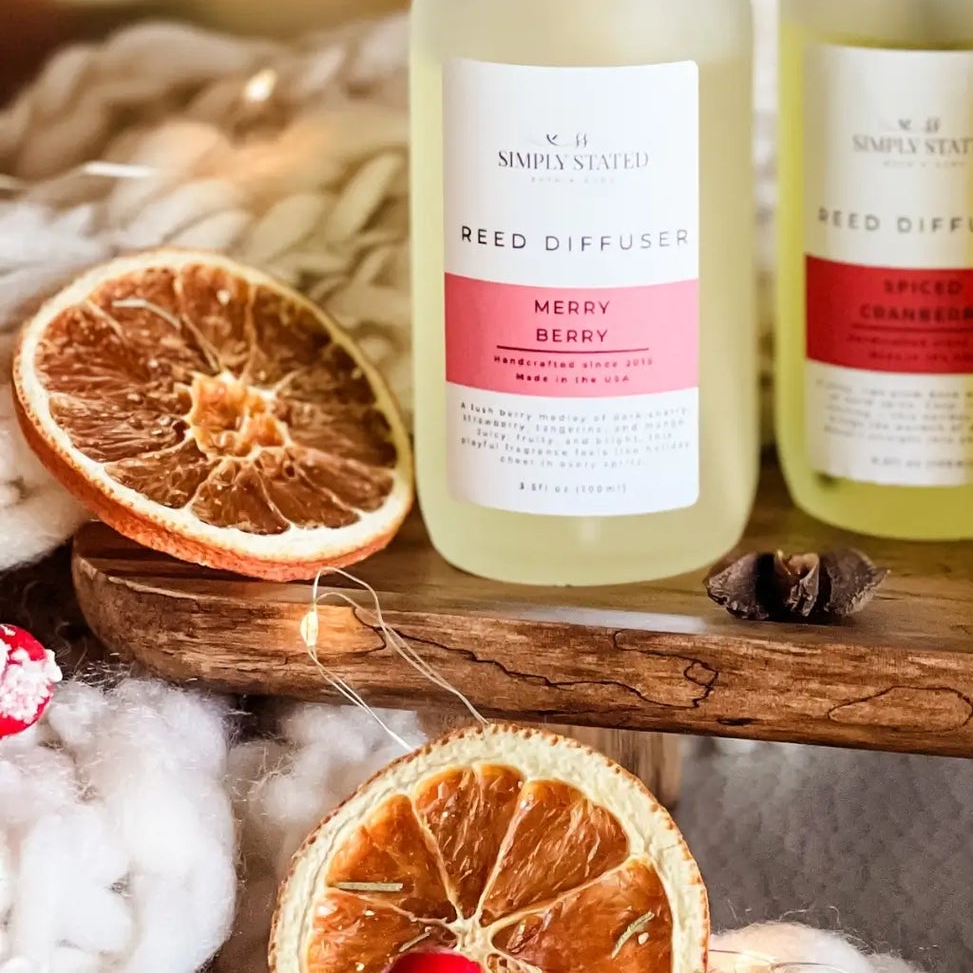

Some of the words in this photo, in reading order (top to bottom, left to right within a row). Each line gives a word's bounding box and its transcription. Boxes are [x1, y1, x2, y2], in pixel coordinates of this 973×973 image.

[852, 134, 917, 155] SIMPLY
[499, 151, 567, 169] SIMPLY
[573, 151, 649, 170] STATED
[818, 207, 880, 231] REED
[462, 226, 526, 249] REED
[546, 229, 689, 251] DIFFUSER
[884, 279, 964, 295] SPICED
[534, 300, 610, 315] MERRY
[536, 329, 608, 343] BERRY
[494, 355, 575, 369] Handcrafted
[582, 360, 618, 369] since
[516, 373, 548, 383] Made
[556, 375, 568, 383] in
[575, 375, 597, 383] the
[604, 375, 630, 383] USA
